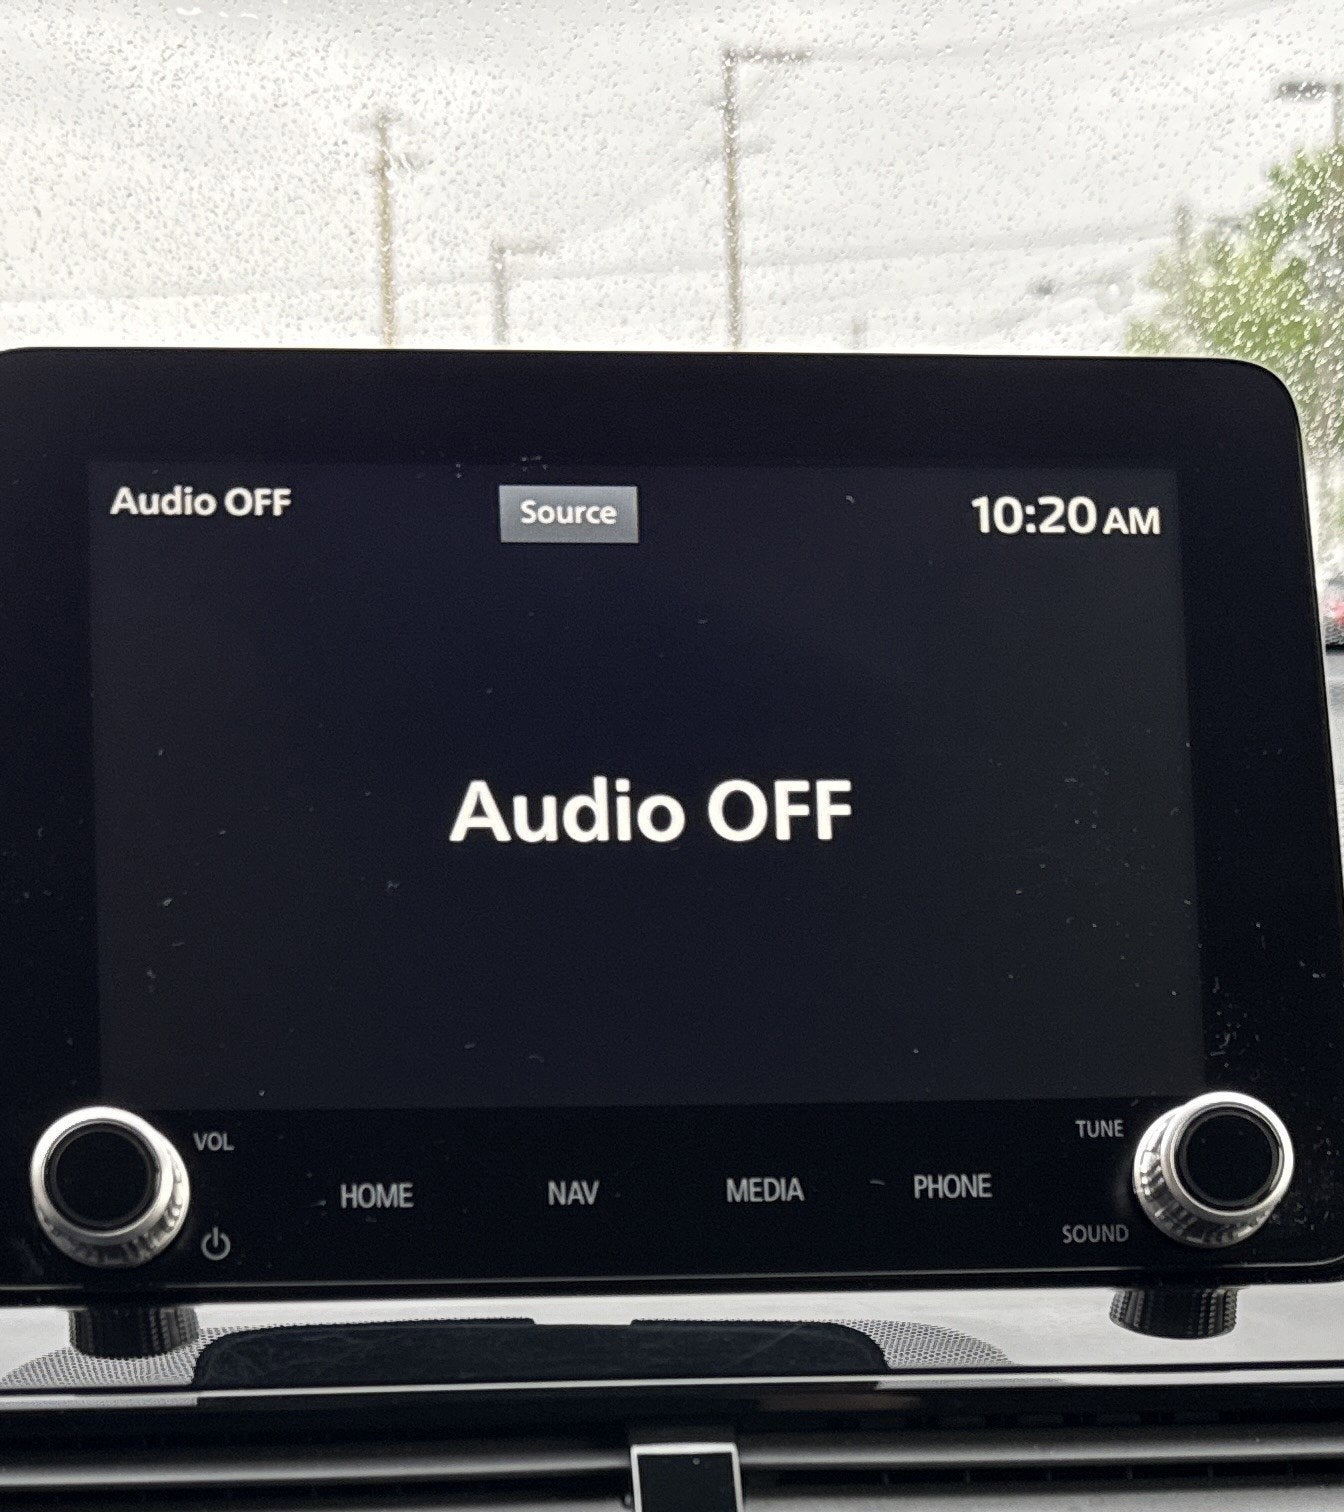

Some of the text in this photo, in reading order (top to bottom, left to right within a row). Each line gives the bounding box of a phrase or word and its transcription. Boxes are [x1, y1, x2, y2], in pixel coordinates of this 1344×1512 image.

[110, 485, 292, 517] Audio OFF
[520, 499, 617, 525] Source
[971, 495, 1161, 535] 10:20 AM
[449, 775, 852, 843] Audio OFF
[193, 1131, 235, 1152] VOL
[1075, 1119, 1124, 1138] TUNE
[340, 1182, 414, 1209] HOME
[548, 1180, 600, 1206] NAV
[726, 1177, 805, 1203] MEDIA
[913, 1173, 993, 1199] PHONE
[1061, 1224, 1129, 1244] SOUND
